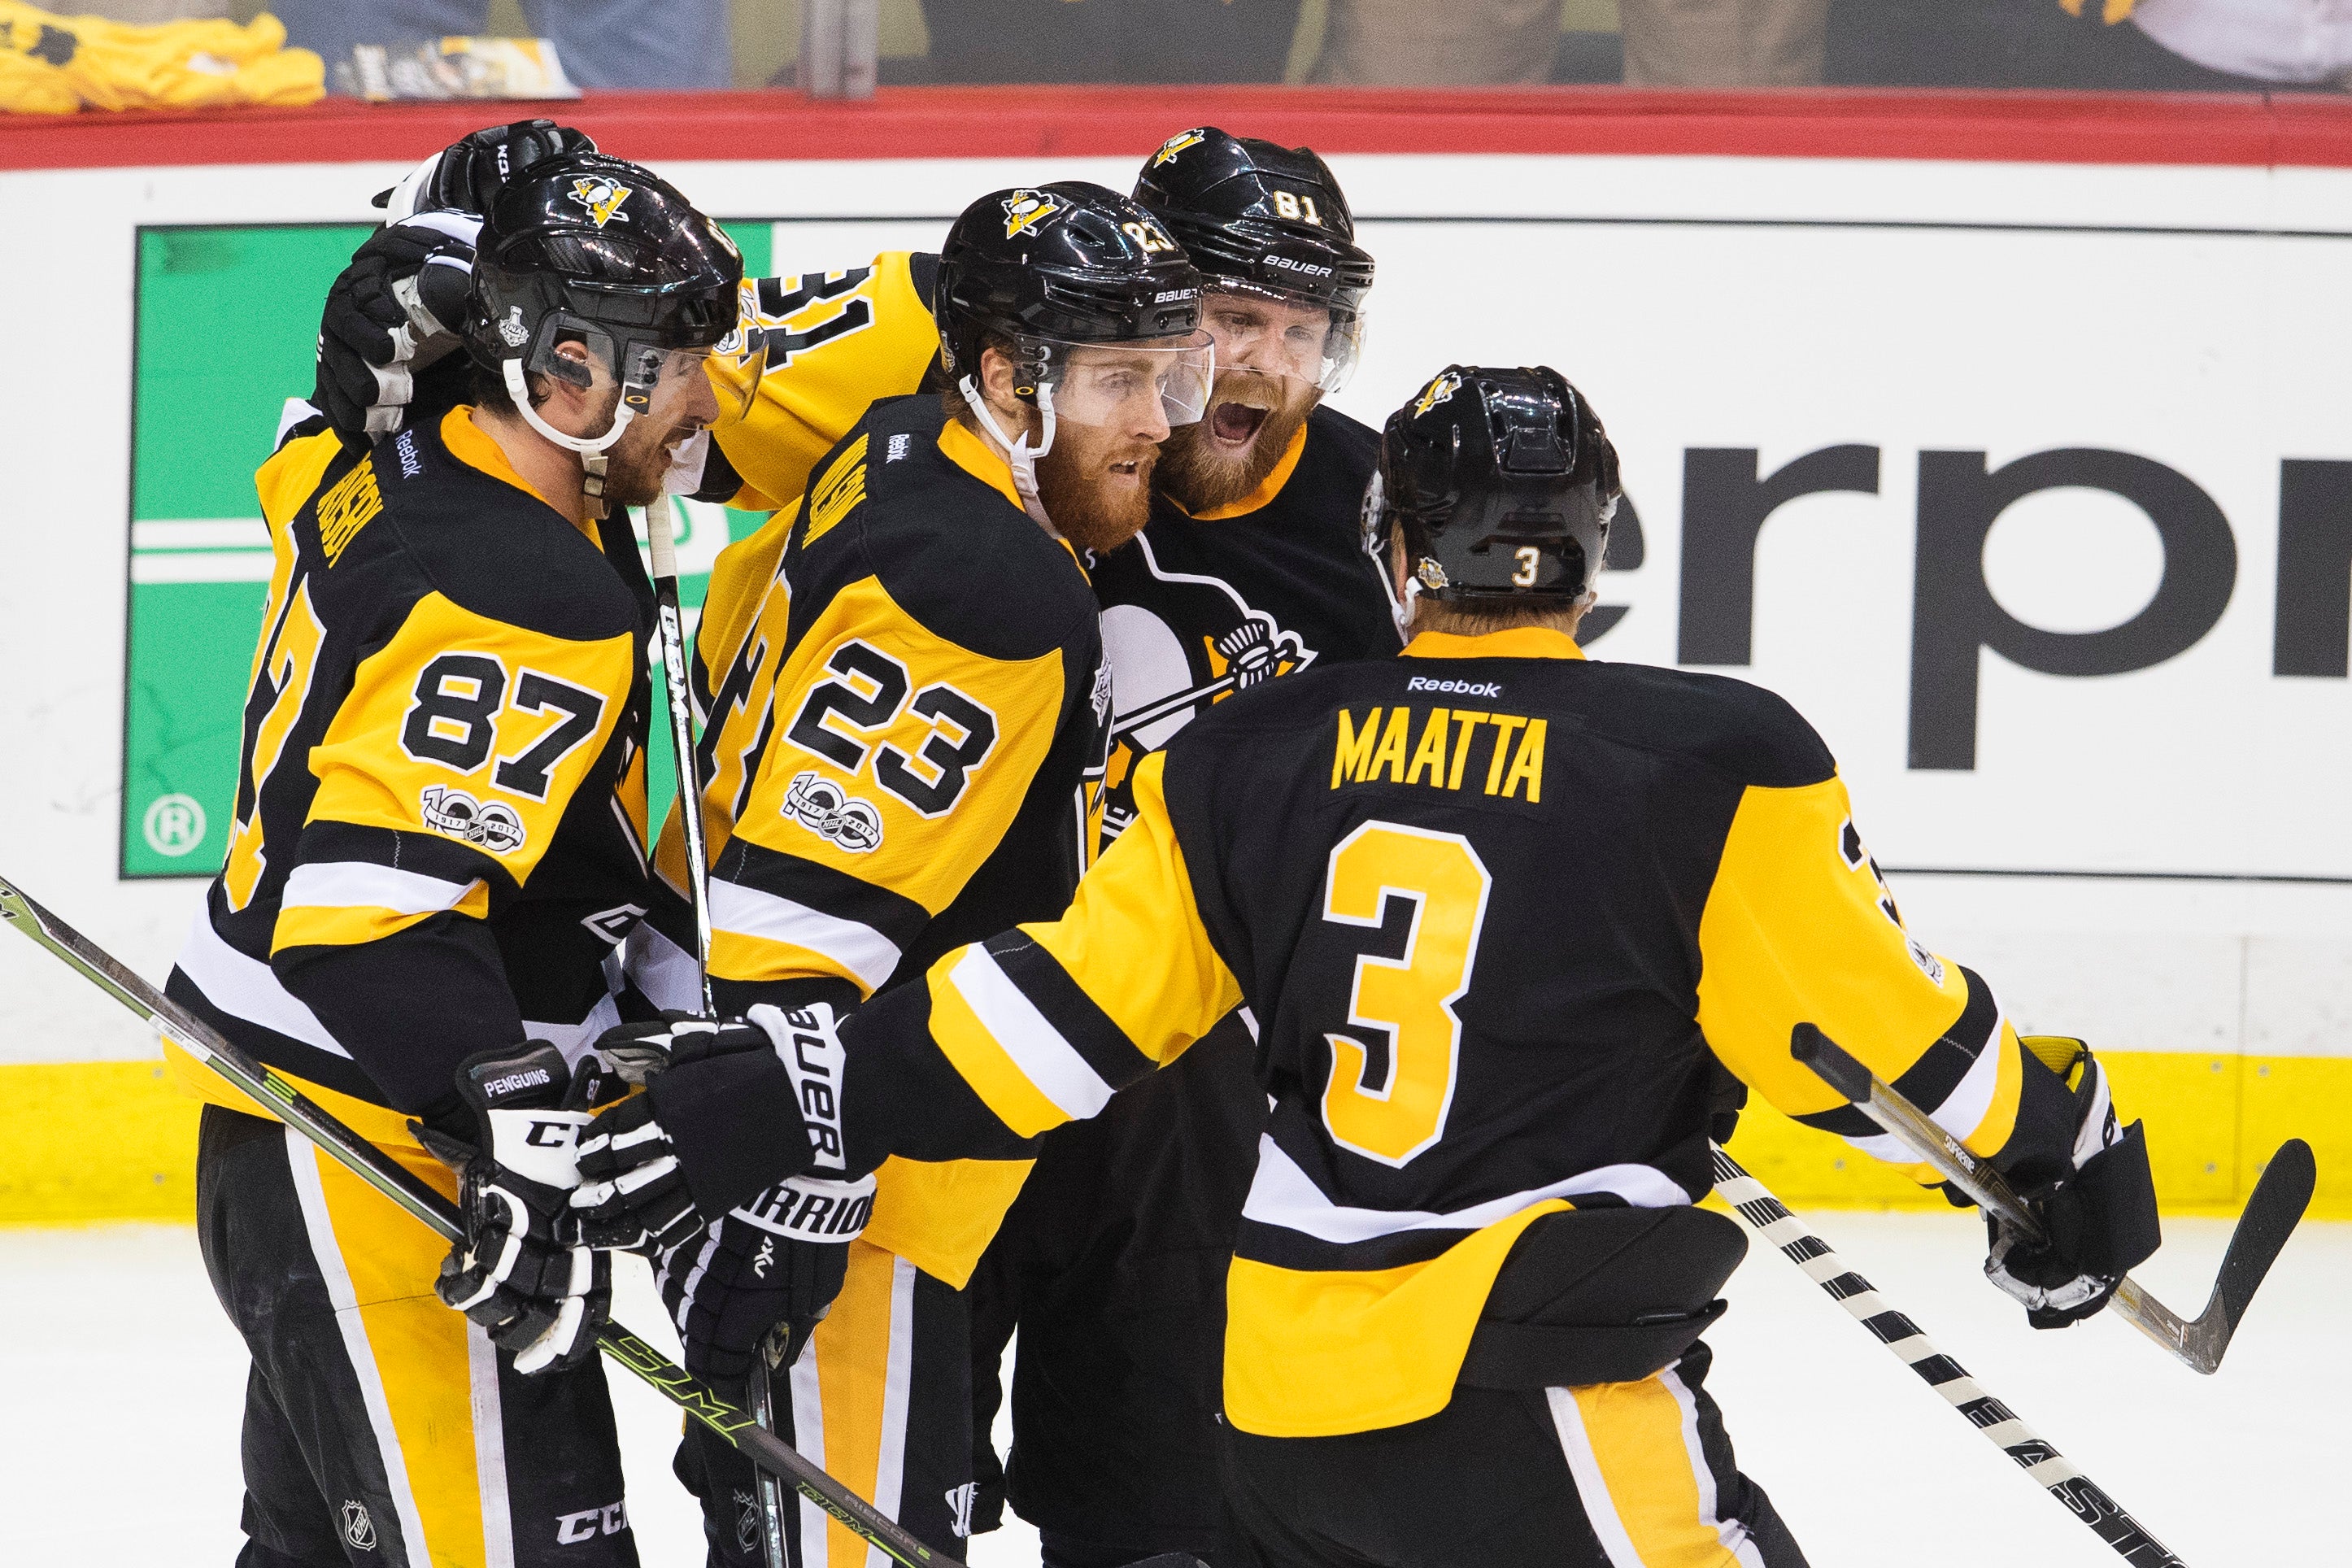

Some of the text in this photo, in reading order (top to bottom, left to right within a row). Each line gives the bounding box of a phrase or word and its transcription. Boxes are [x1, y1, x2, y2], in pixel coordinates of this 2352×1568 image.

[1273, 189, 1322, 226] 81
[1262, 254, 1334, 278] BAUER
[395, 429, 423, 480] Reebok
[1511, 546, 1540, 588] 3
[1576, 442, 2352, 771] rp
[1407, 677, 1502, 698] Reebok
[399, 651, 610, 804] 87
[782, 637, 1000, 821] 23
[1331, 706, 1548, 804] MAATTA
[435, 814, 517, 835] 1917 2017
[795, 796, 874, 838] 1917 2017
[821, 818, 843, 829] NHL
[1321, 819, 1492, 1169] 3
[483, 1068, 550, 1098] PENGUINS
[587, 1078, 600, 1101] 87
[598, 1318, 757, 1449] CM
[1956, 1395, 2189, 1568] EAST
[796, 1480, 875, 1537] CCM
